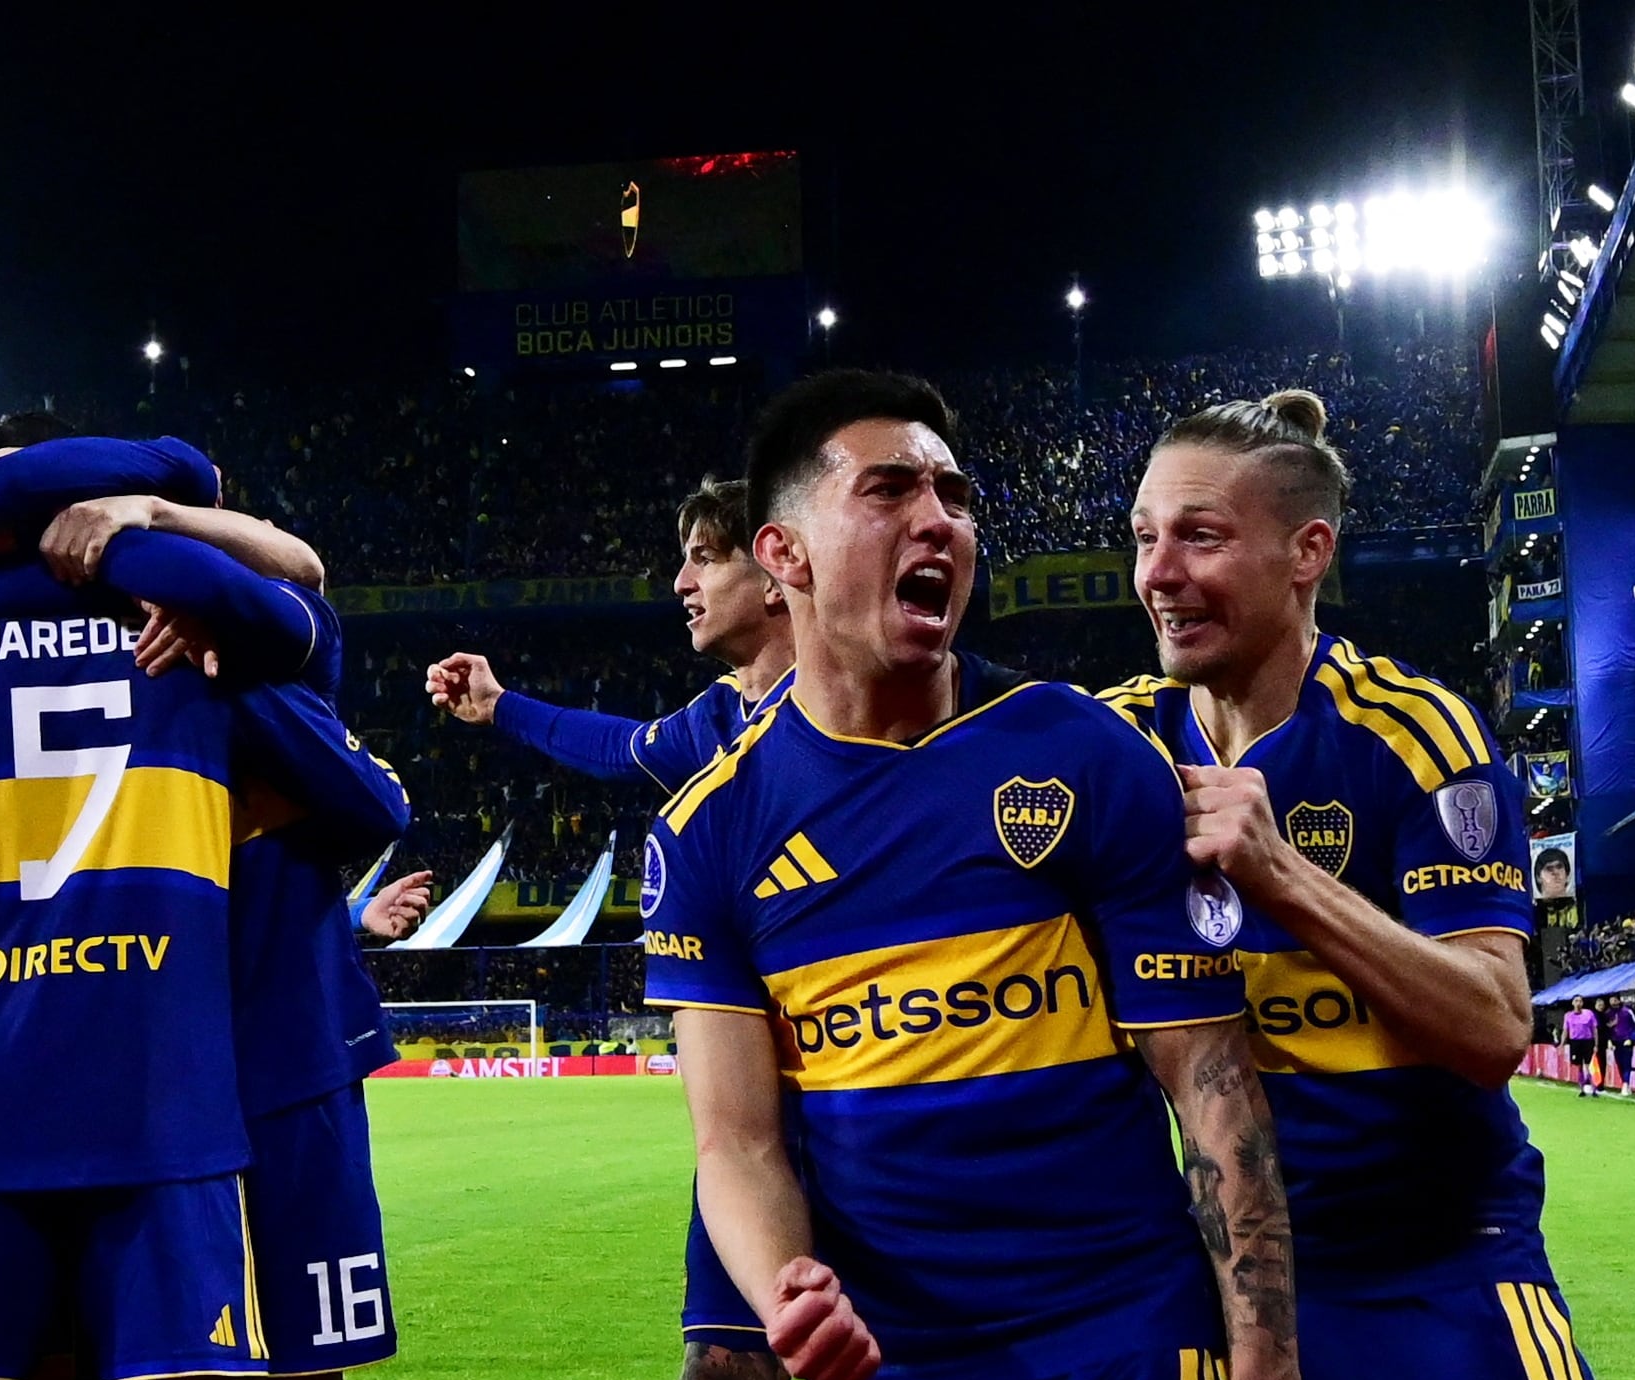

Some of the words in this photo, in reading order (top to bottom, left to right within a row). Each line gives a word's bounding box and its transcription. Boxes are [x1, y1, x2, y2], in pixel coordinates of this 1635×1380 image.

[515, 300, 589, 327] CLUB
[516, 330, 596, 356] BOCA
[602, 322, 734, 351] JUNIORS
[1516, 491, 1553, 517] PARRA
[10, 678, 132, 901] 5
[1002, 805, 1063, 828] CABJ
[1296, 829, 1347, 848] CABJ
[1469, 834, 1480, 852] 2
[1402, 862, 1526, 896] CETROGAR
[1212, 923, 1225, 937] 2
[794, 962, 1089, 1055] betsson
[306, 1252, 388, 1348] 16
